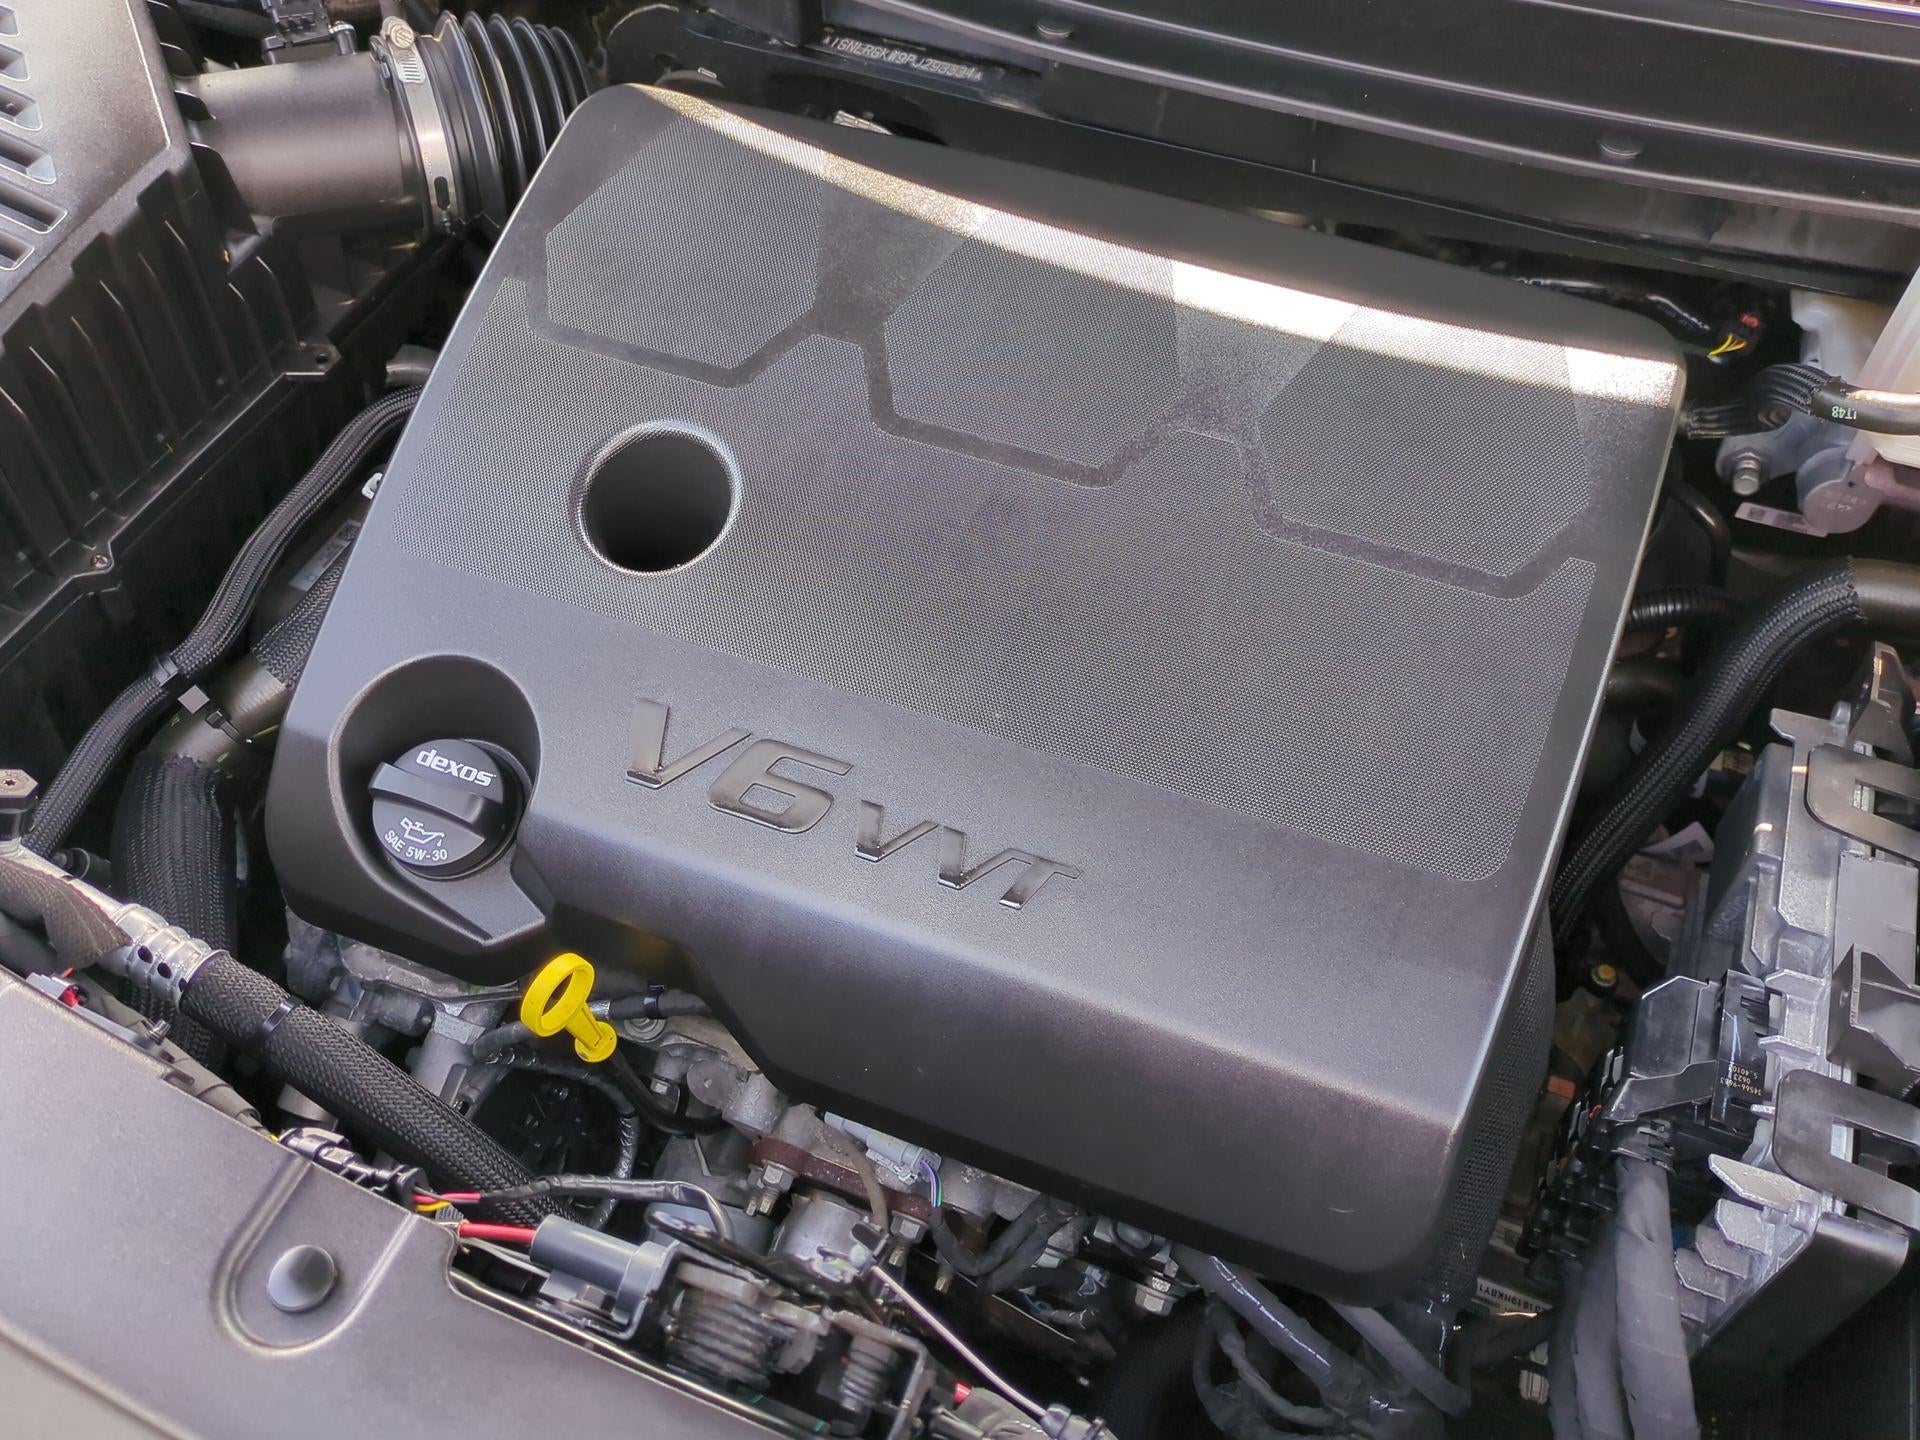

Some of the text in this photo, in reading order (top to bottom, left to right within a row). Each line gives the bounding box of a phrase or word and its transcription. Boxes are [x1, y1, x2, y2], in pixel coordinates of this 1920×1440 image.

[416, 749, 493, 787] dexos
[626, 697, 1084, 910] V6 VVT
[384, 830, 448, 861] SAE 5W-30
